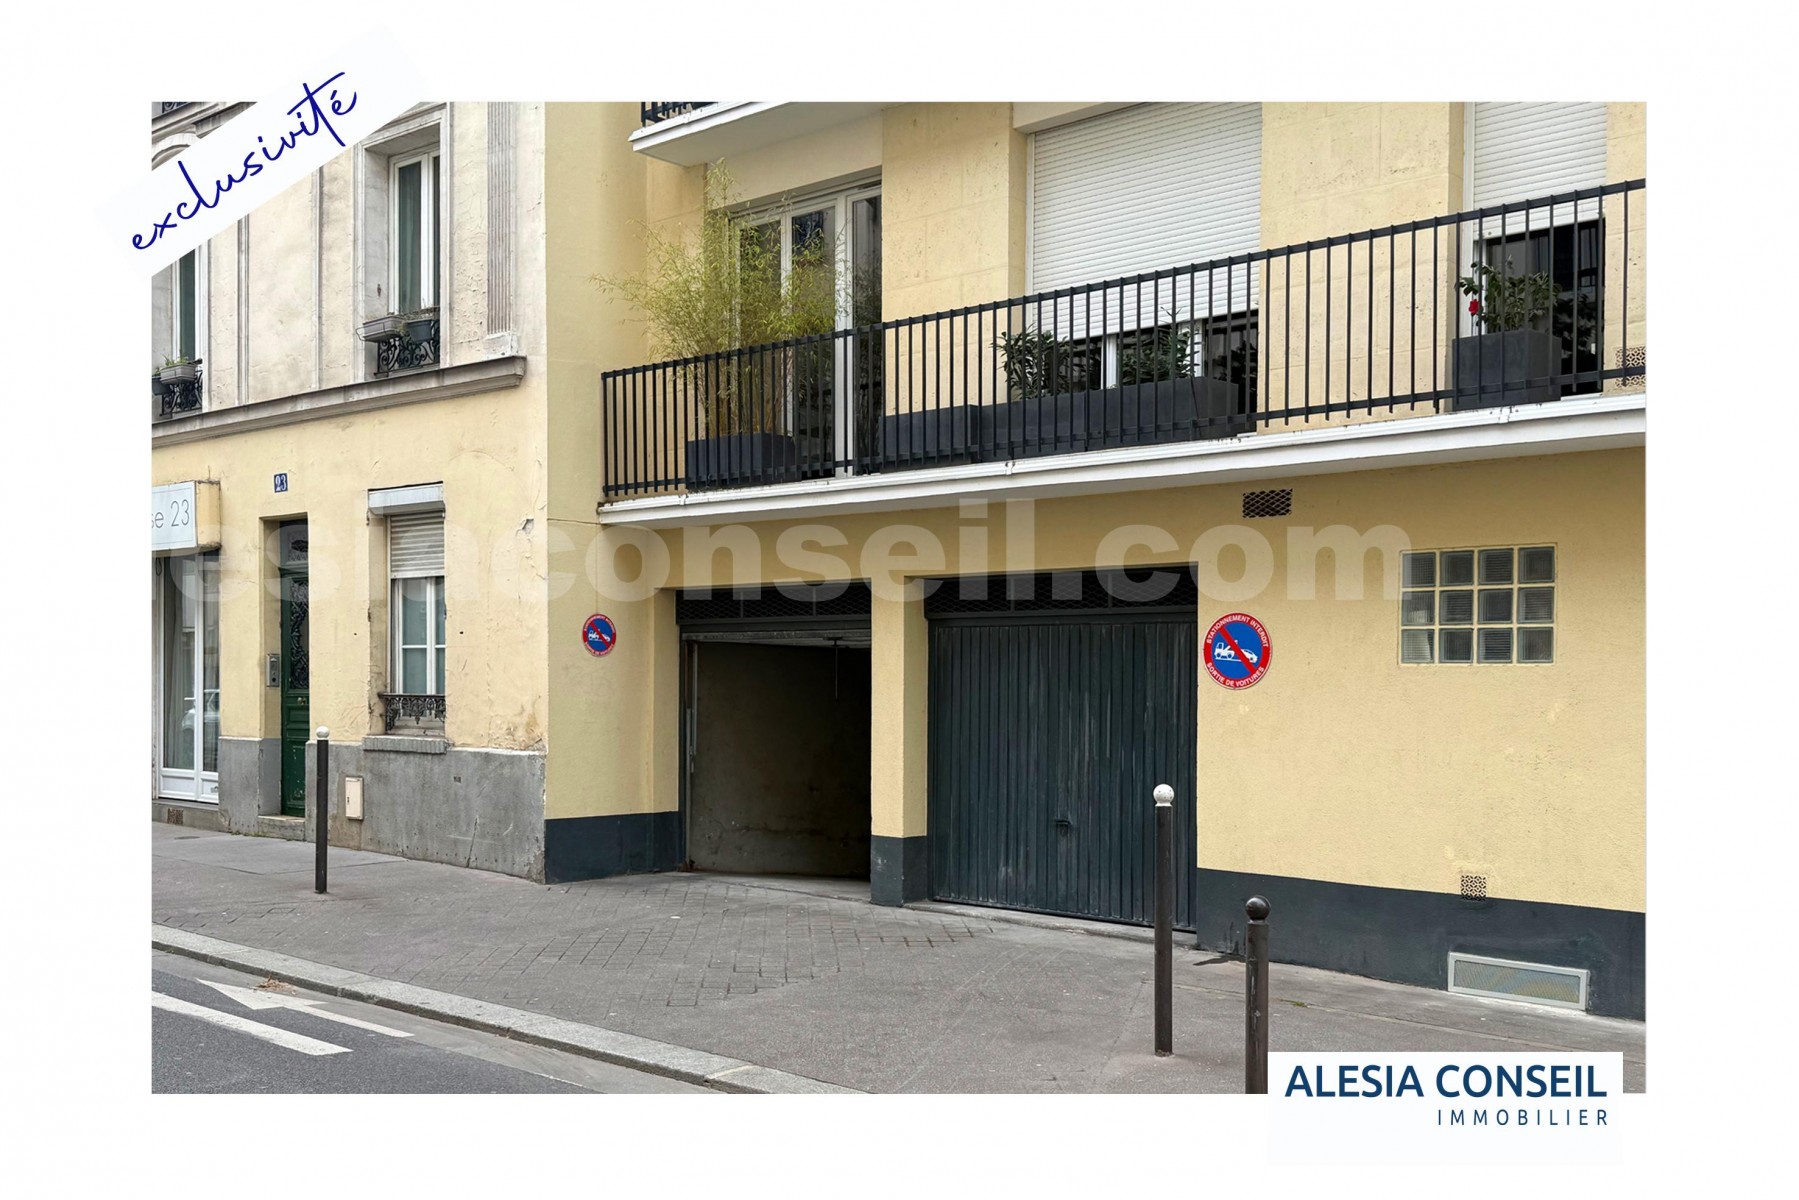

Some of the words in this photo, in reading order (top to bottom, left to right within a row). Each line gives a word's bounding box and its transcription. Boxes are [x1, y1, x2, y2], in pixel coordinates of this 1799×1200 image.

[274, 475, 288, 492] 23
[170, 499, 190, 527] 23
[1206, 615, 1251, 644] STATIONNEMENT
[1250, 620, 1269, 648] INTERDIT
[1206, 662, 1225, 684] SORTIE
[1225, 679, 1234, 687] DE
[1235, 667, 1264, 687] VOITURES
